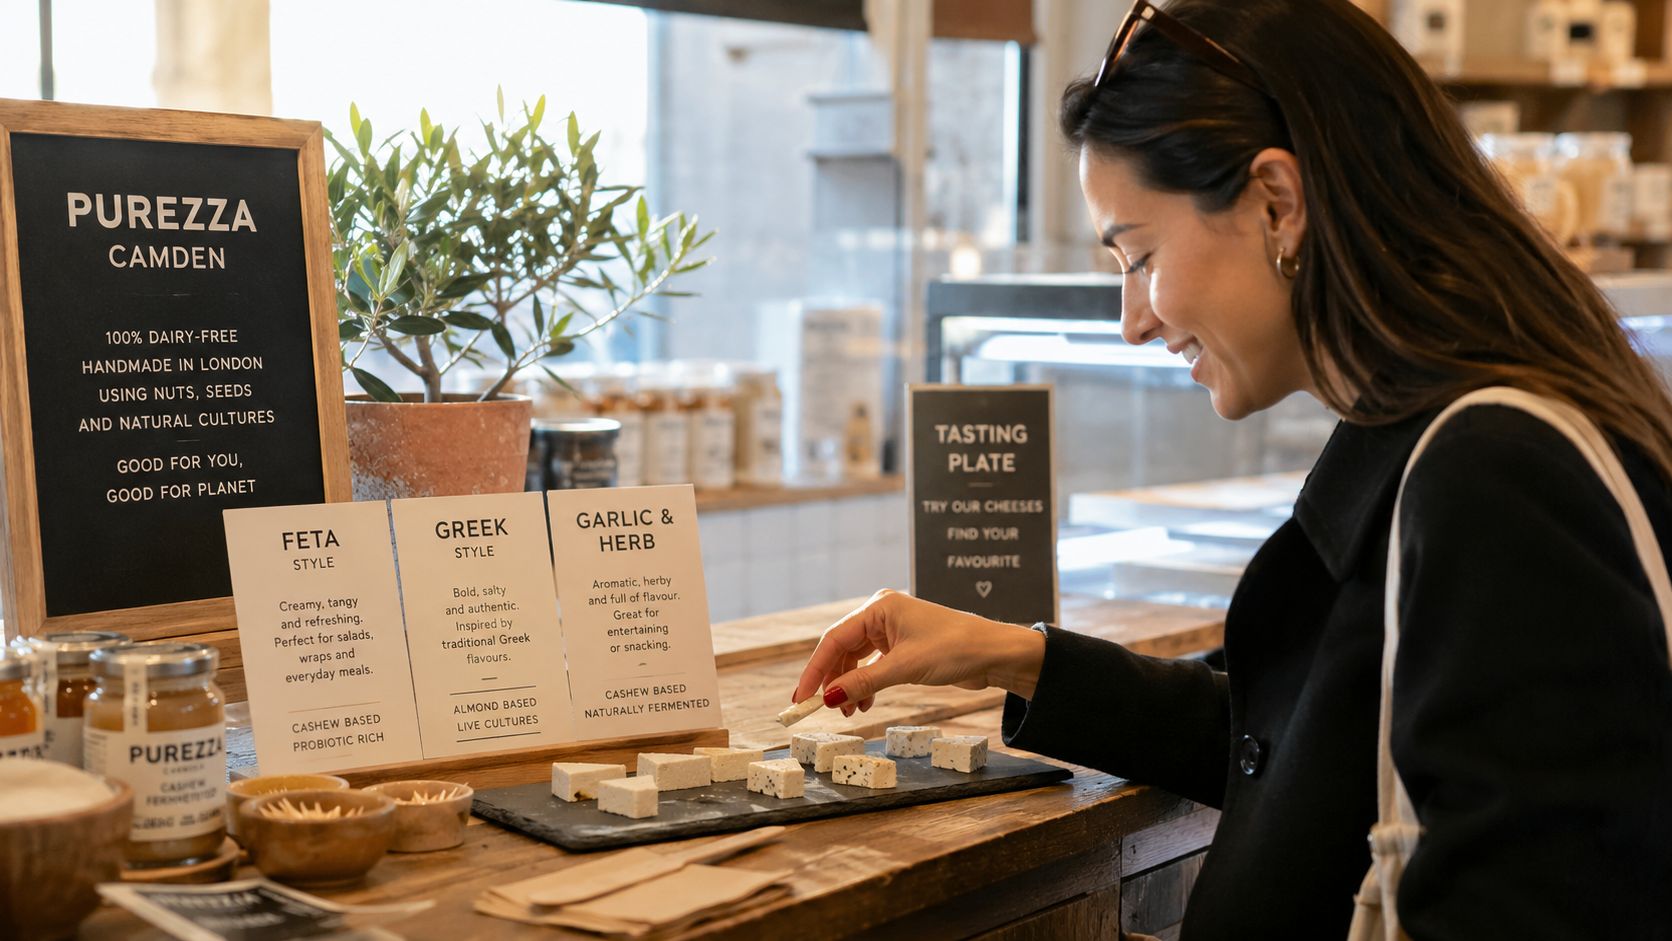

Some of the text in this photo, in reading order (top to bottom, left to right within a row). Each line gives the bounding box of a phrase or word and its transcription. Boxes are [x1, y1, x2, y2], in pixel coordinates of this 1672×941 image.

[67, 192, 257, 232] PUREZZA
[109, 245, 225, 269] CAMDEN
[106, 330, 237, 344] 100% DAIRY-FREE
[83, 357, 262, 374] HANDMADE IN LONDON
[99, 384, 251, 402] USING NUTS, SEEDS
[79, 410, 274, 432] AND NATURAL CULTURES
[935, 424, 1027, 443] TASTING
[117, 453, 242, 473] GOOD FOR YOU,
[949, 453, 1015, 472] PLATE
[107, 480, 255, 503] GOOD FOR PLANET
[922, 500, 1043, 513] TRY OUR CHEESES
[577, 509, 674, 529] GARLIC &
[436, 518, 508, 539] GREEK
[947, 527, 1018, 540] FIND YOUR
[282, 530, 340, 550] FETA
[600, 534, 655, 552] HERB
[455, 546, 494, 558] STYLE
[293, 557, 334, 570] STYLE
[947, 555, 1020, 568] FAVOURITE
[643, 576, 671, 587] herby
[483, 585, 506, 597] salty
[589, 592, 680, 605] and full of flavour.
[328, 598, 358, 608] tangy
[446, 601, 519, 615] and authentic.
[281, 614, 363, 629] and refreshing.
[614, 607, 659, 620] Great for
[456, 618, 512, 632] Inspired by
[607, 624, 668, 636] entertaining
[274, 635, 315, 647] Perfect
[318, 633, 333, 643] for
[442, 633, 530, 649] traditional Greek
[624, 640, 670, 651] snacking.
[299, 648, 355, 664] wraps and
[467, 654, 511, 664] flavours.
[286, 664, 373, 683] everyday meals.
[606, 684, 686, 699] CASHEW BASED
[454, 698, 536, 714] ALMOND BASED
[585, 699, 709, 718] NATURALLY FERMENTED
[292, 714, 380, 733] CASHEW BASED
[458, 715, 538, 731] LIVE CULTURES
[293, 732, 384, 751] PROBIOTIC RICH
